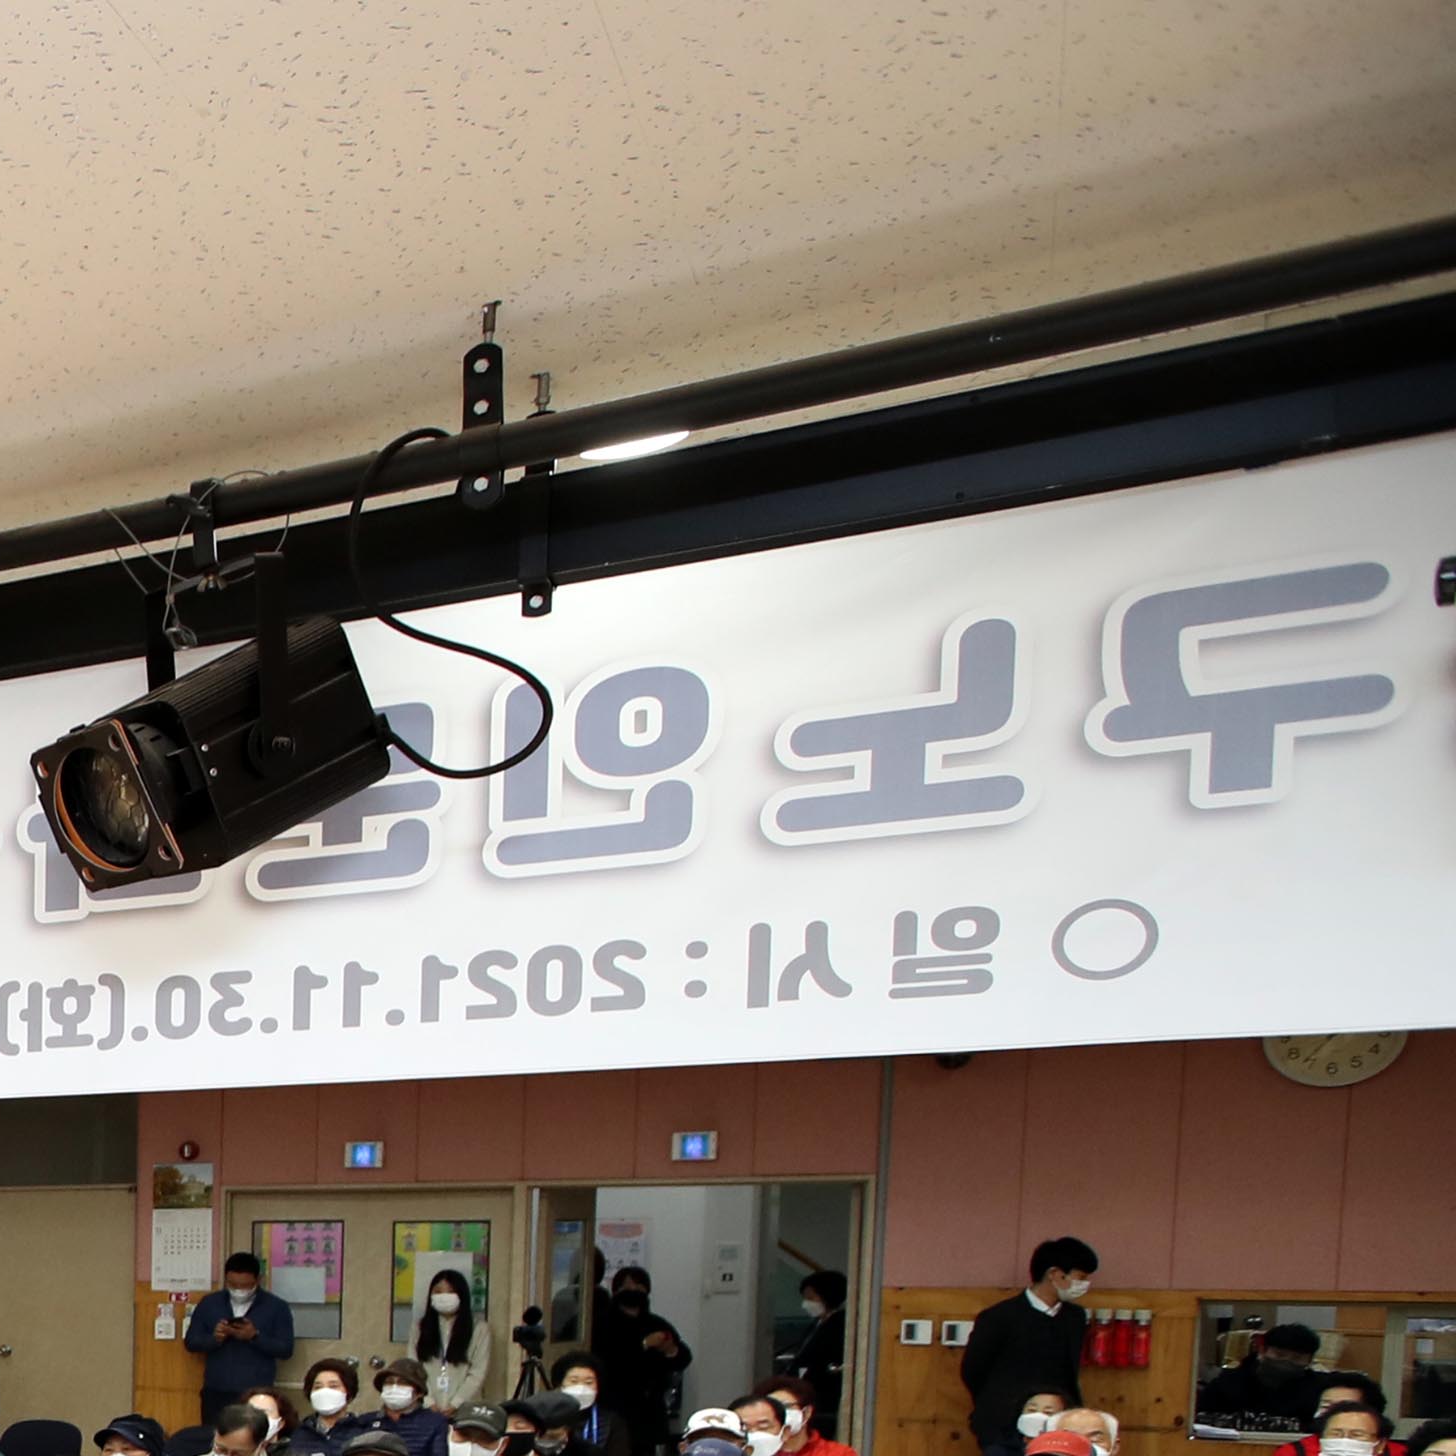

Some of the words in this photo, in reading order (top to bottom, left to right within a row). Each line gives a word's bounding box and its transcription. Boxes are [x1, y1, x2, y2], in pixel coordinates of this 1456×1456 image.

[1288, 1047, 1300, 1060] 8
[1368, 1043, 1380, 1055] 4
[1326, 1061, 1338, 1075] 6
[1350, 1055, 1362, 1068] 5
